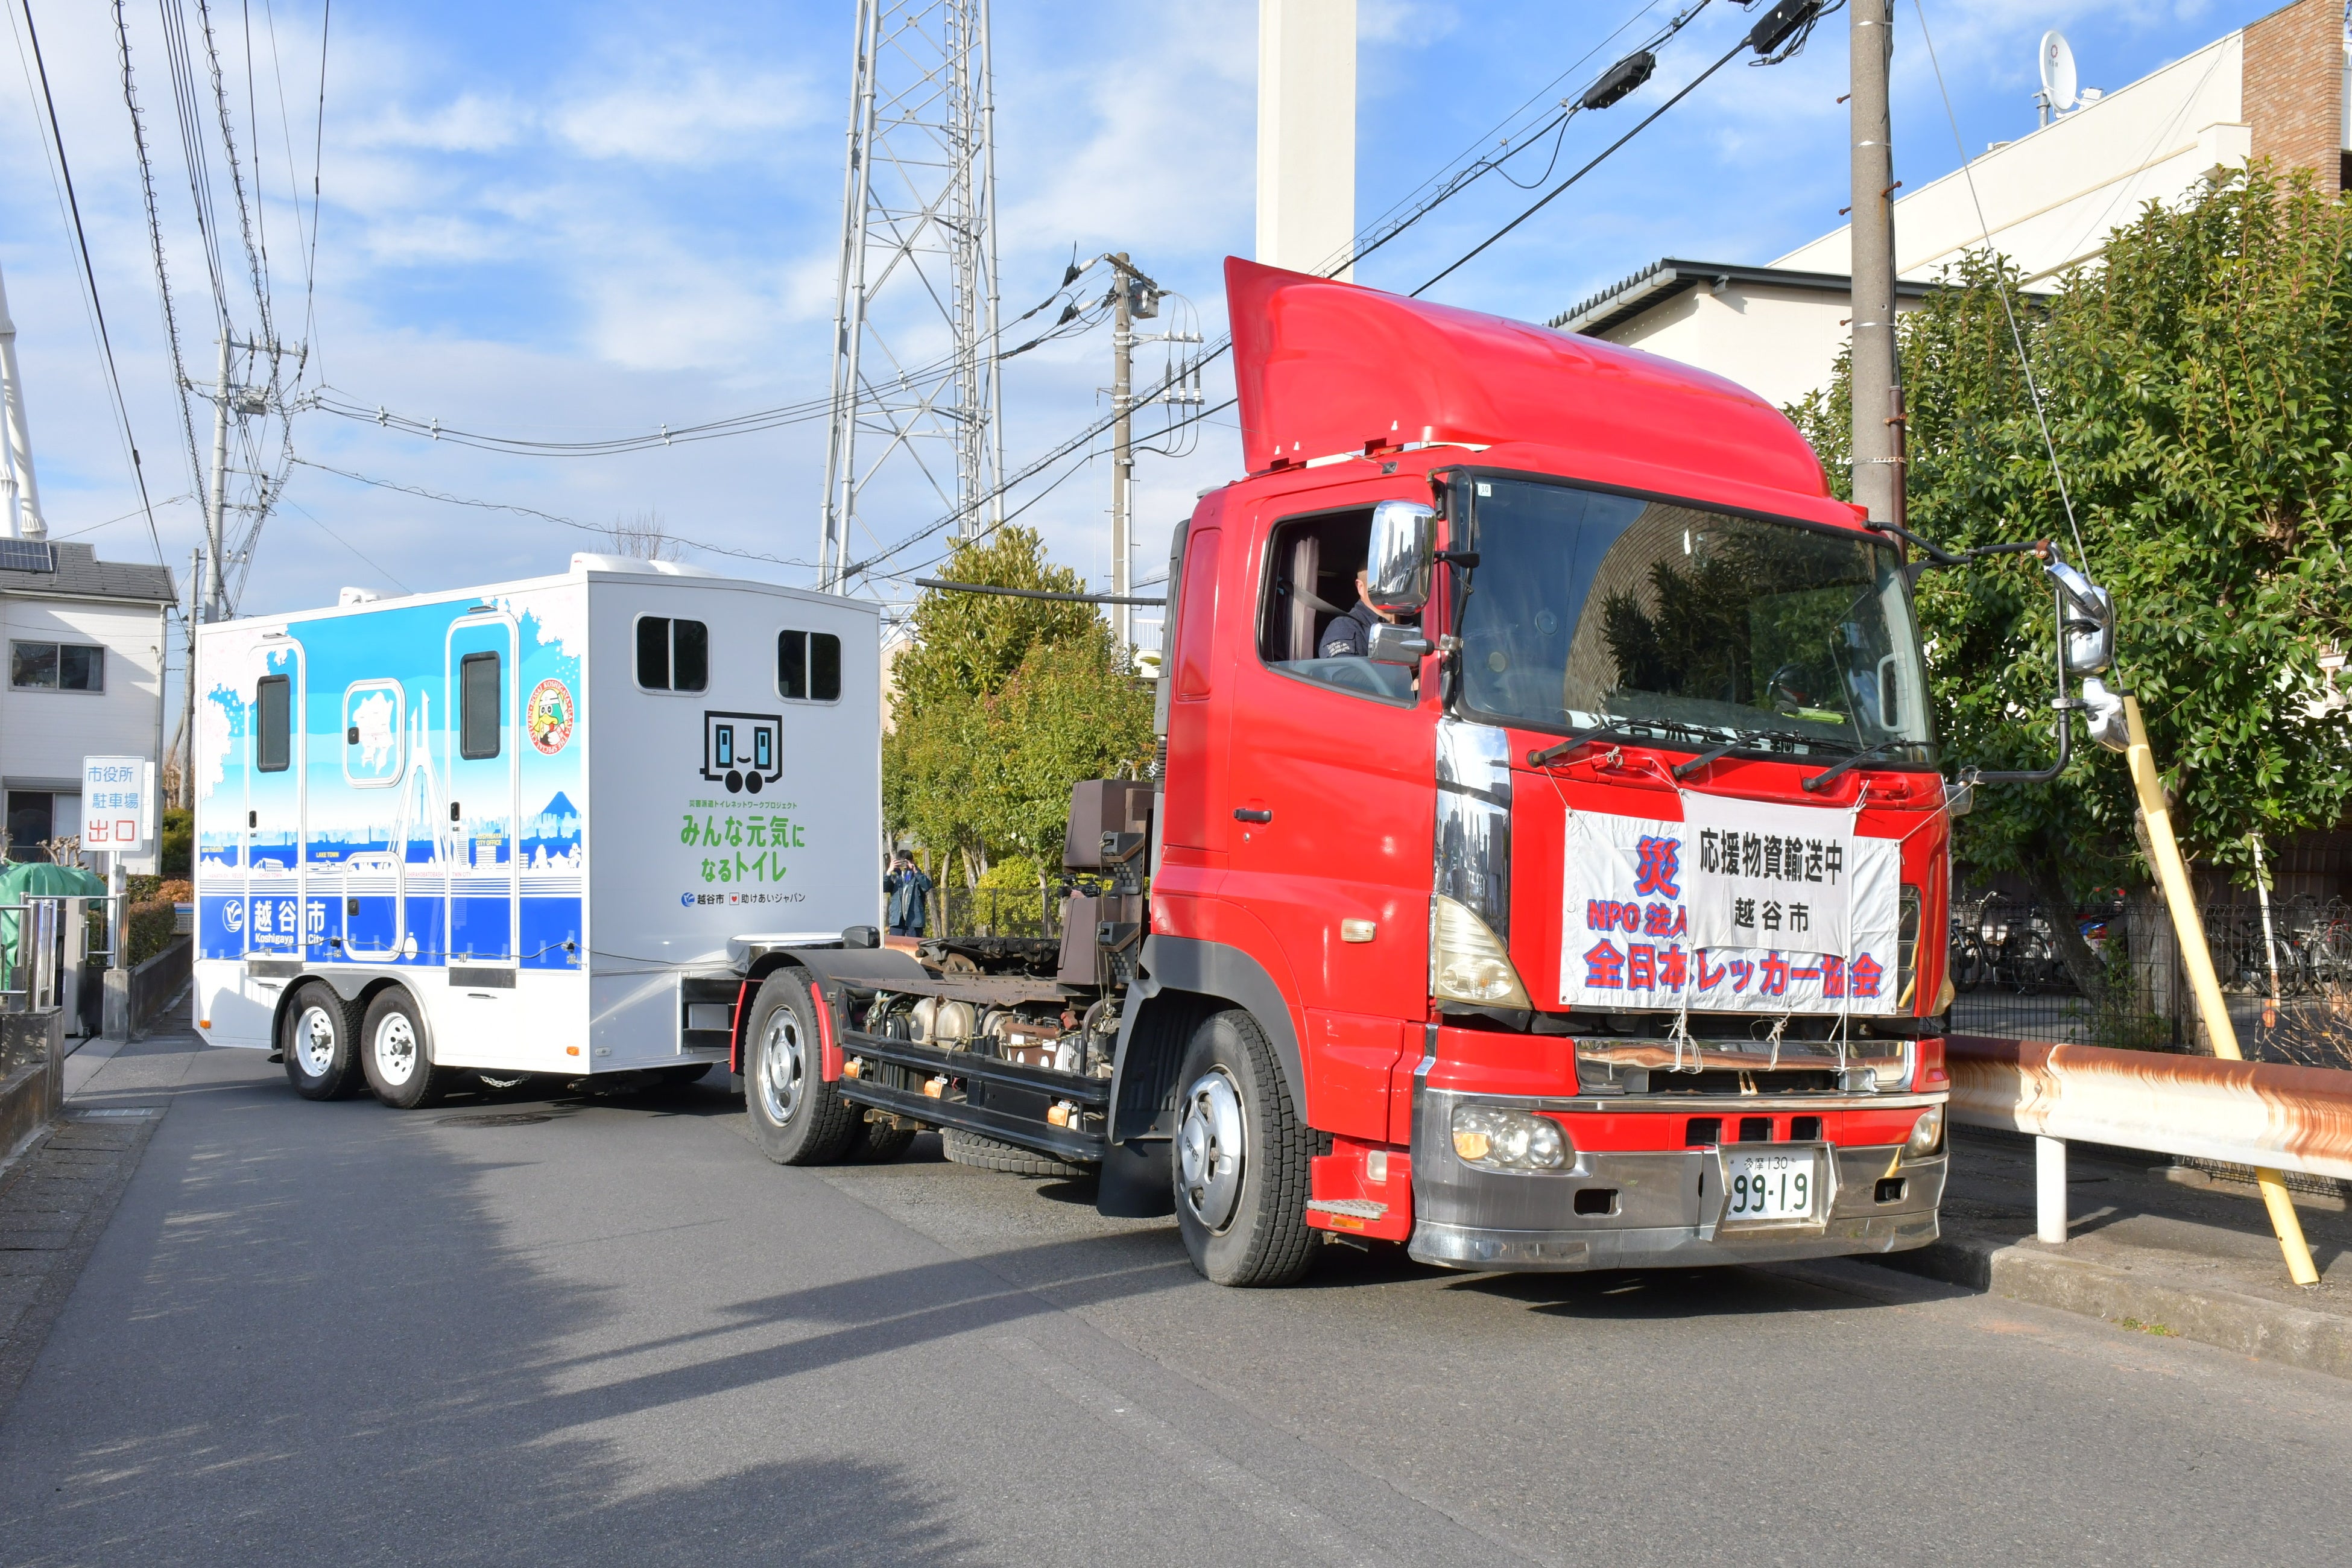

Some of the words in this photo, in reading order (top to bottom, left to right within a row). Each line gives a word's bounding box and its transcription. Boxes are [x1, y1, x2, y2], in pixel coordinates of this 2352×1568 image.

[88, 767, 133, 783] 市役所
[92, 792, 139, 809] 駐車場
[89, 819, 135, 842] 出口
[681, 815, 805, 848] みんな元気に
[701, 851, 786, 882] なるトイレ
[1633, 835, 1681, 900] 災
[1699, 827, 1843, 885] 応援物資輸送中
[697, 894, 724, 905] 越谷市
[741, 894, 806, 903] 助けあいジャパン
[254, 900, 326, 934] 越谷市
[1734, 897, 1809, 933] 越谷市
[254, 932, 294, 944] Koshigaya
[308, 934, 324, 946] City
[1582, 938, 1883, 999] 全日本レッカー協会
[1732, 1173, 1807, 1213] 99-19
